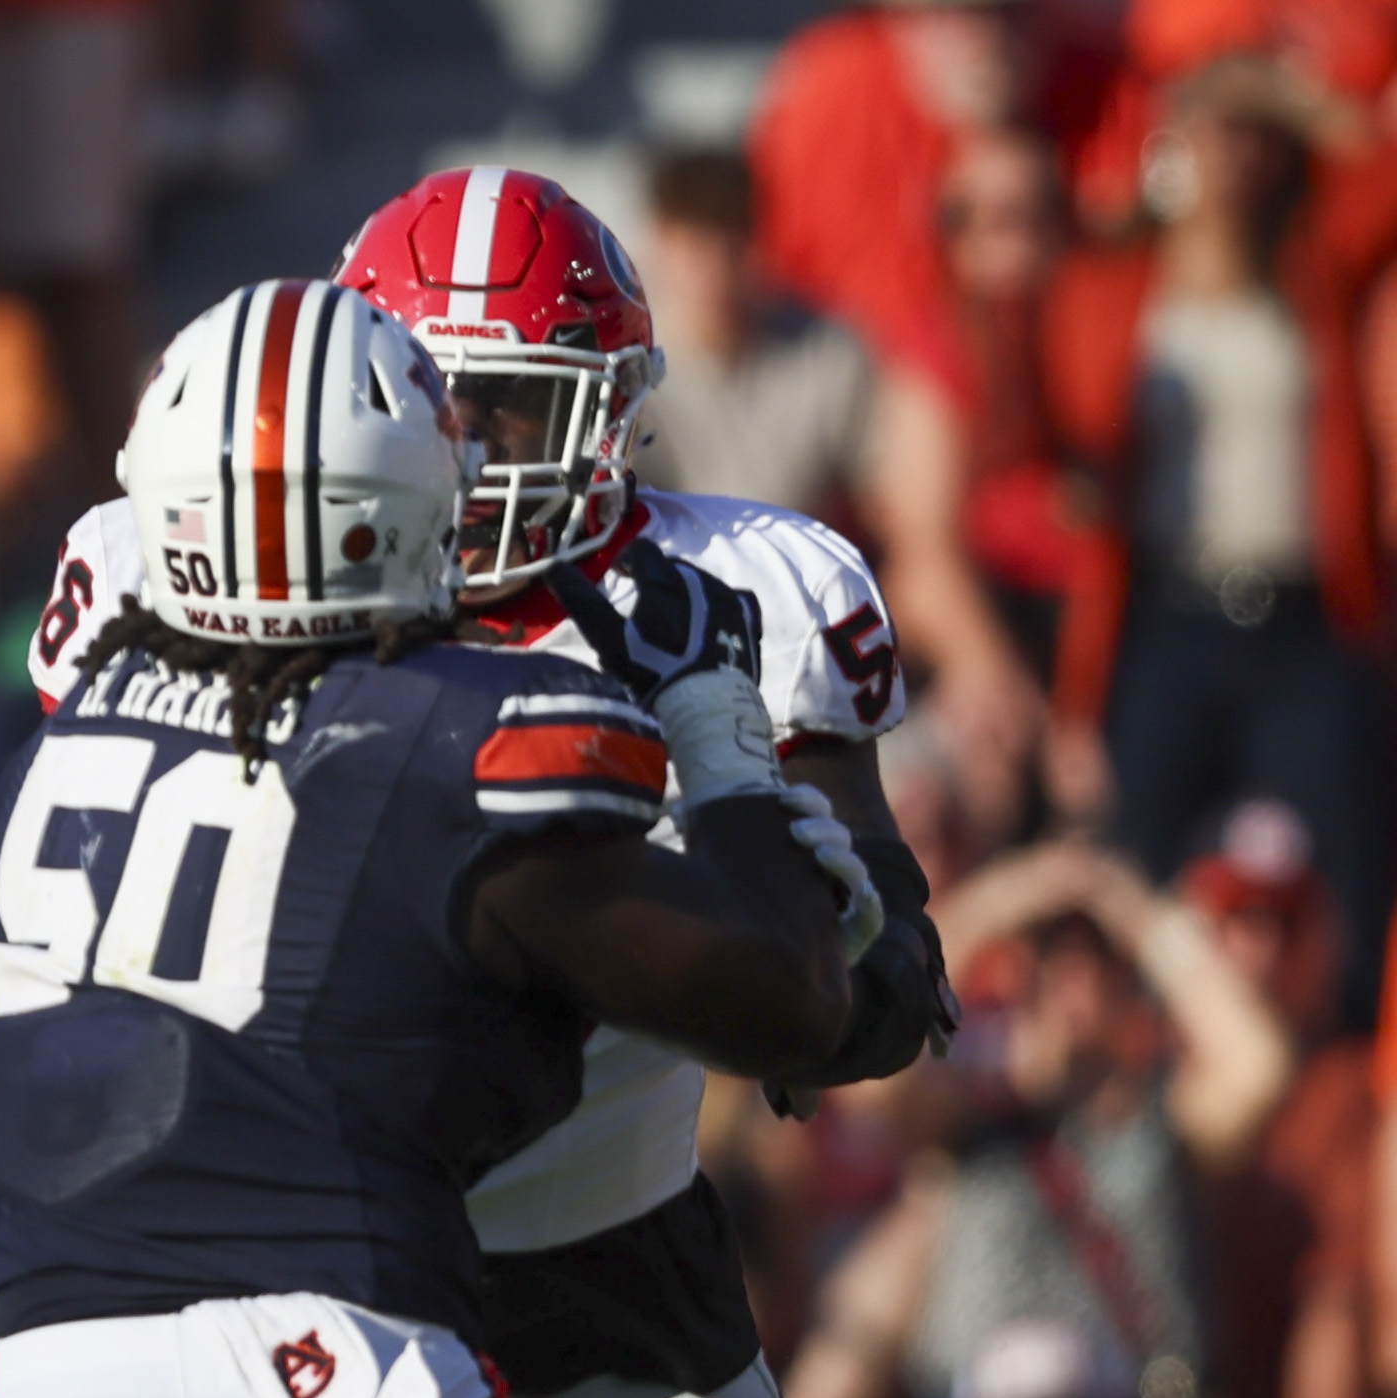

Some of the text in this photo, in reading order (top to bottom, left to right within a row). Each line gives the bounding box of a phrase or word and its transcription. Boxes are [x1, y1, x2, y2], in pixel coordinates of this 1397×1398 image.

[428, 322, 507, 340] DAWGS
[164, 547, 218, 597] 50
[184, 607, 374, 639] WAR EAGLE
